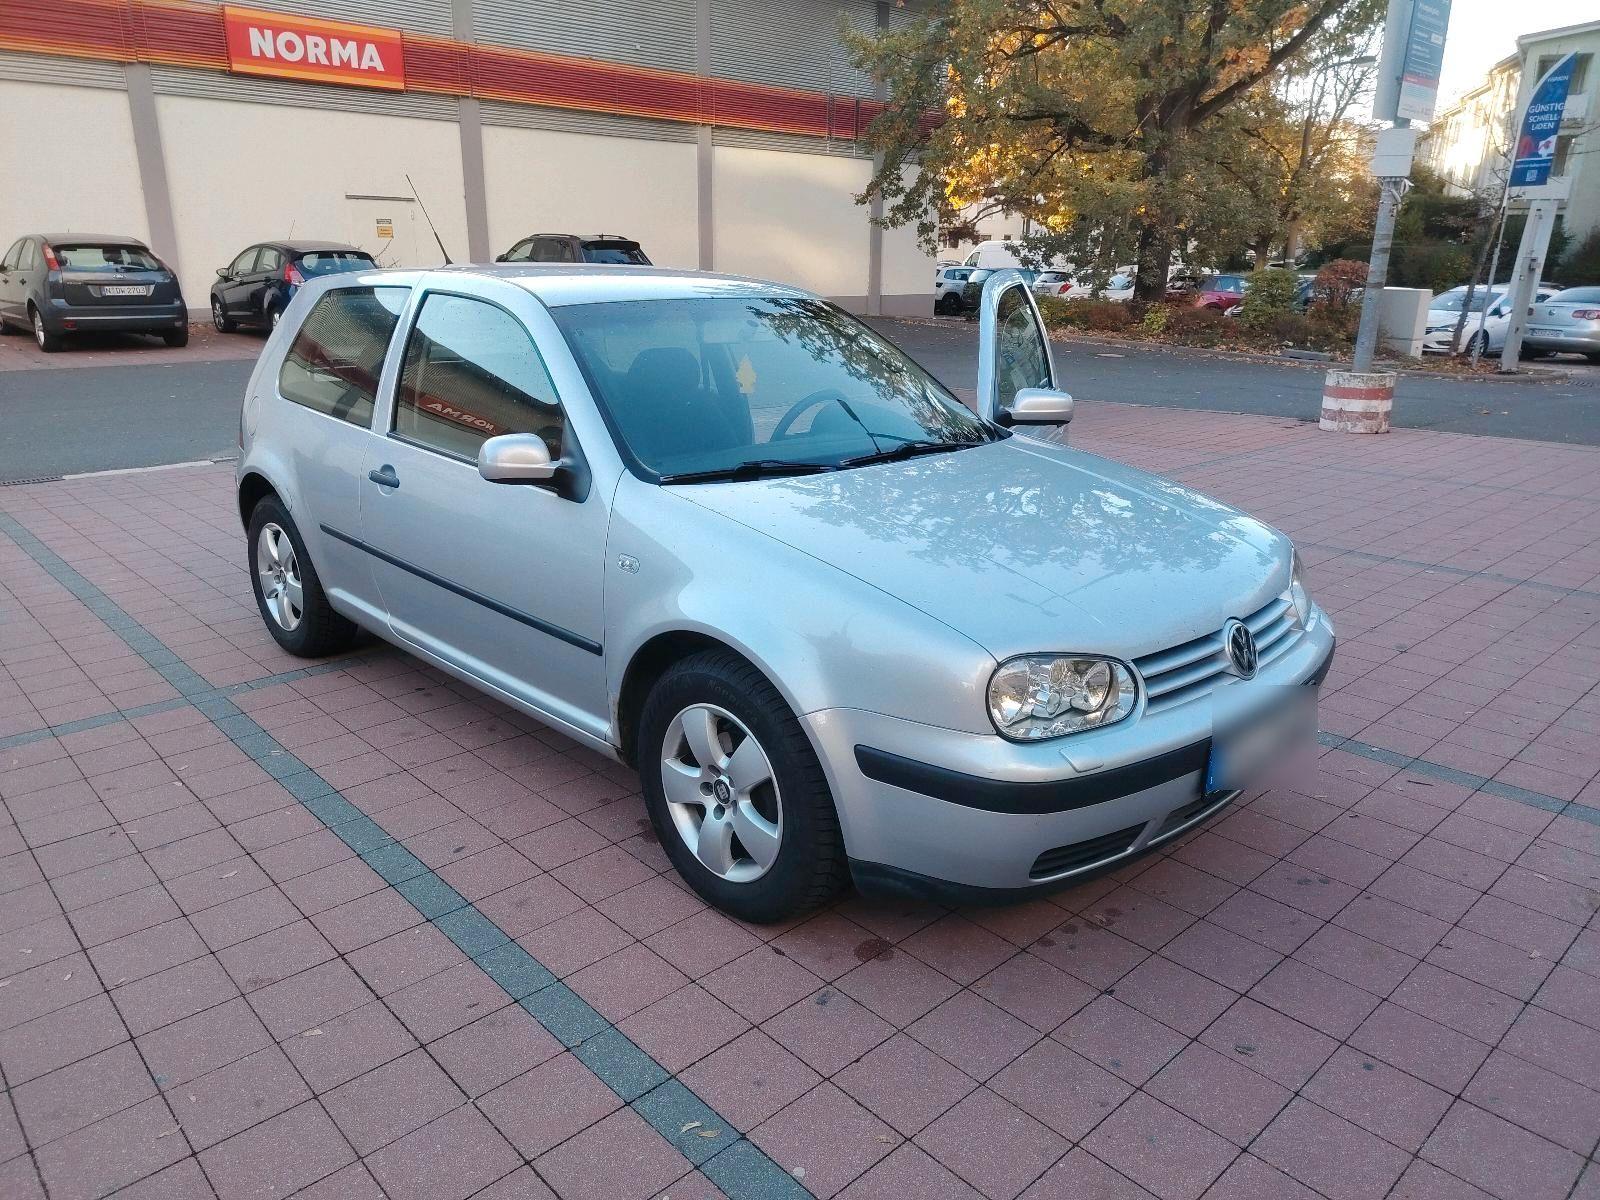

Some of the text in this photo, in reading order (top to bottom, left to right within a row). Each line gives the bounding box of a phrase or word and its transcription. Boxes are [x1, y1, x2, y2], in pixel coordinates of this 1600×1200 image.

[248, 27, 385, 72] NORMA
[1531, 122, 1554, 131] LADEN
[127, 286, 146, 294] 2703
